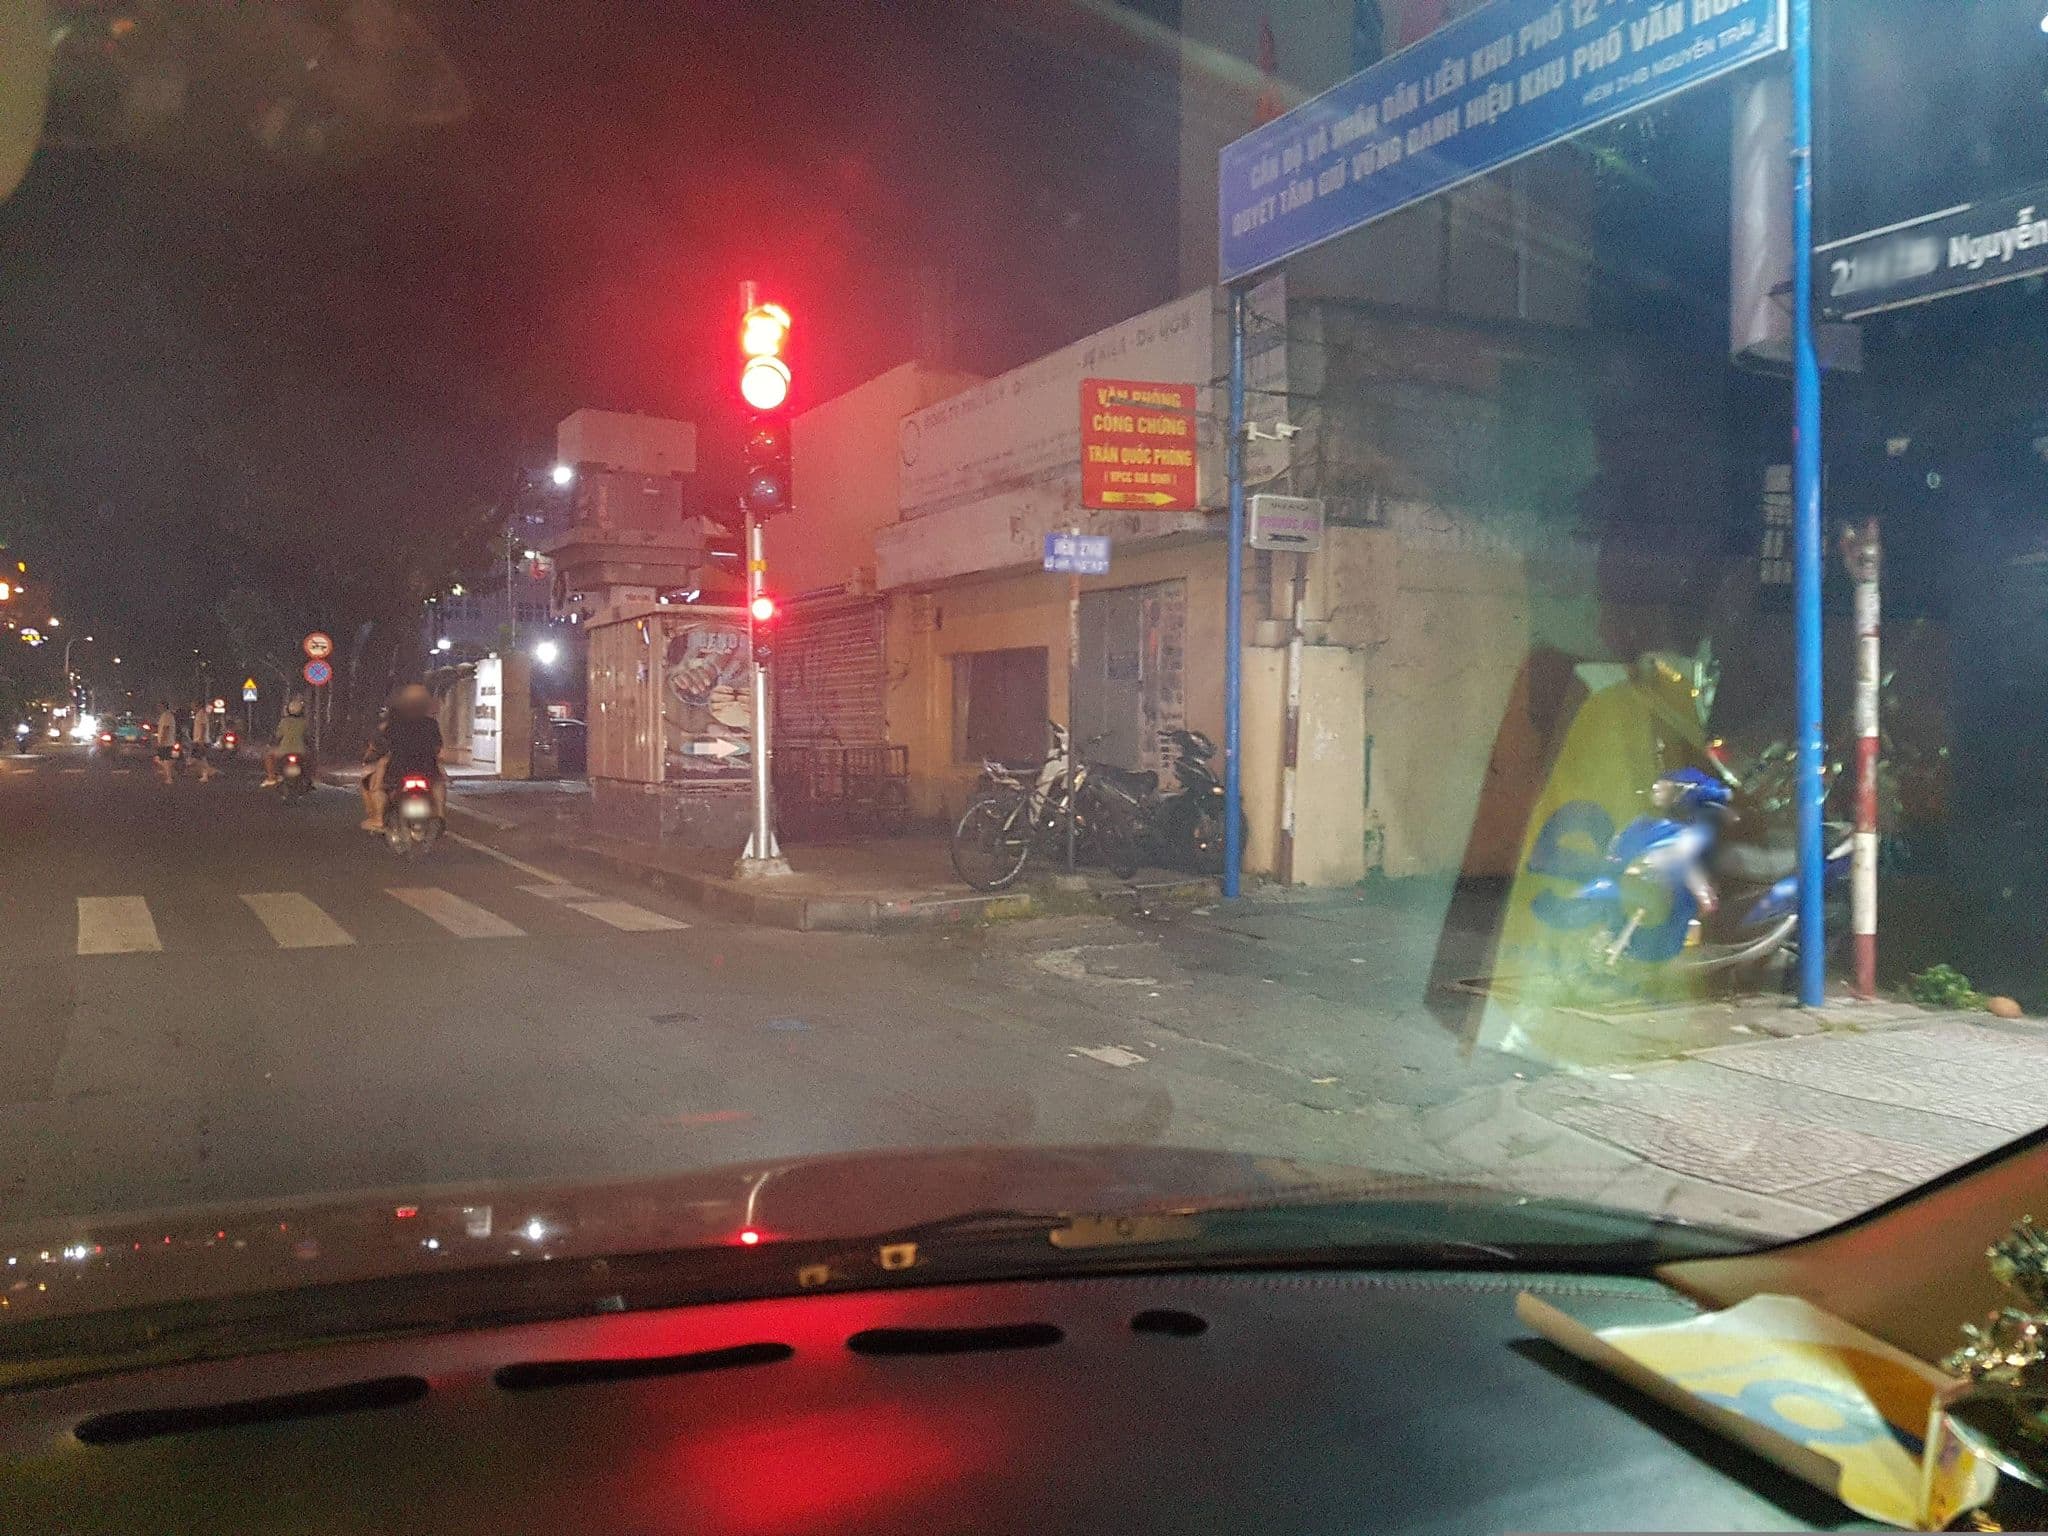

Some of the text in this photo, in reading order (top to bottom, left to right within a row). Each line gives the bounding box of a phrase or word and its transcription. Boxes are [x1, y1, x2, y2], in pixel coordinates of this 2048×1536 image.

[1407, 107, 1459, 156] DANH
[1466, 81, 1513, 128] HIỆU
[1520, 56, 1566, 104] KHU
[1572, 19, 1626, 79] PHỐ
[1631, 0, 1685, 51] VĂN
[1425, 57, 1466, 104] LIÊN
[1472, 35, 1512, 80] KHU
[1519, 2, 1563, 56] PHỐ
[1949, 205, 2048, 270] Nguyễn
[1094, 412, 1187, 435] CÔNG CHỨNG
